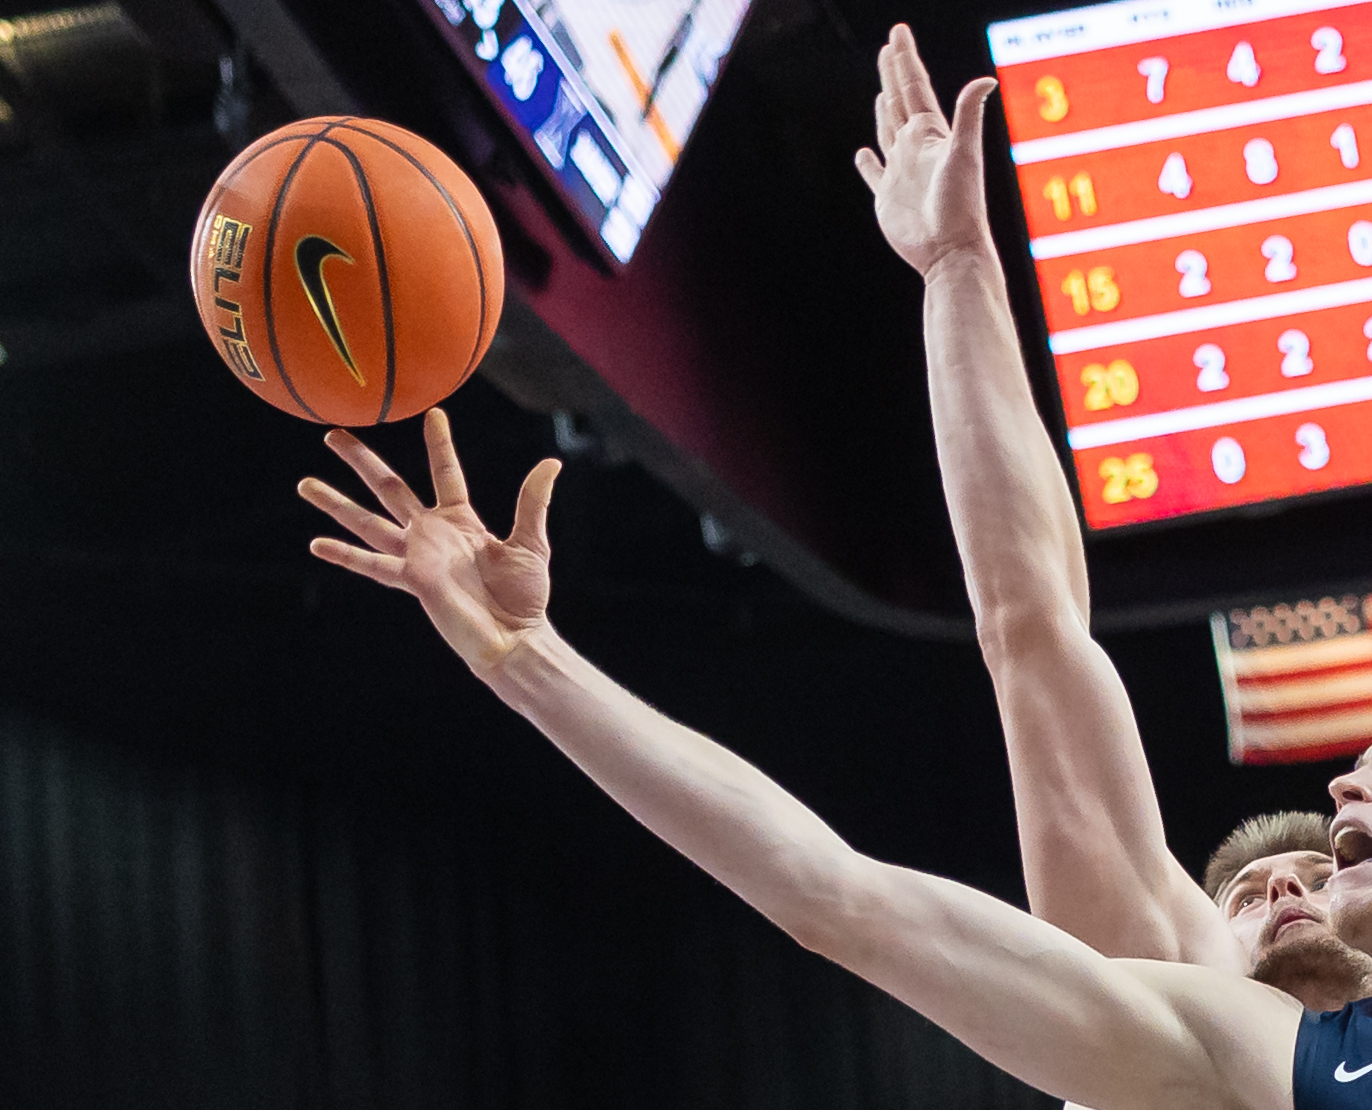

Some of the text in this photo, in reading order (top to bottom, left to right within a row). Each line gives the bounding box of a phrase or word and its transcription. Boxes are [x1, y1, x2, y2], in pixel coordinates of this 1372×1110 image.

[1034, 75, 1069, 122] 3
[1137, 56, 1169, 103] 7
[1226, 41, 1261, 87] 4
[1310, 26, 1347, 74] 2
[1042, 171, 1098, 221] 11
[1157, 152, 1193, 199] 4
[1330, 123, 1360, 169] 1
[213, 215, 267, 383] ELITE
[1061, 265, 1120, 316] 15
[1174, 249, 1212, 298] 2
[1260, 234, 1298, 283] 2
[1080, 359, 1139, 411] 20
[1192, 343, 1230, 393] 2
[1277, 329, 1314, 378] 2
[1098, 453, 1159, 504] 25
[1211, 437, 1246, 485] 0
[1295, 422, 1330, 471] 3
